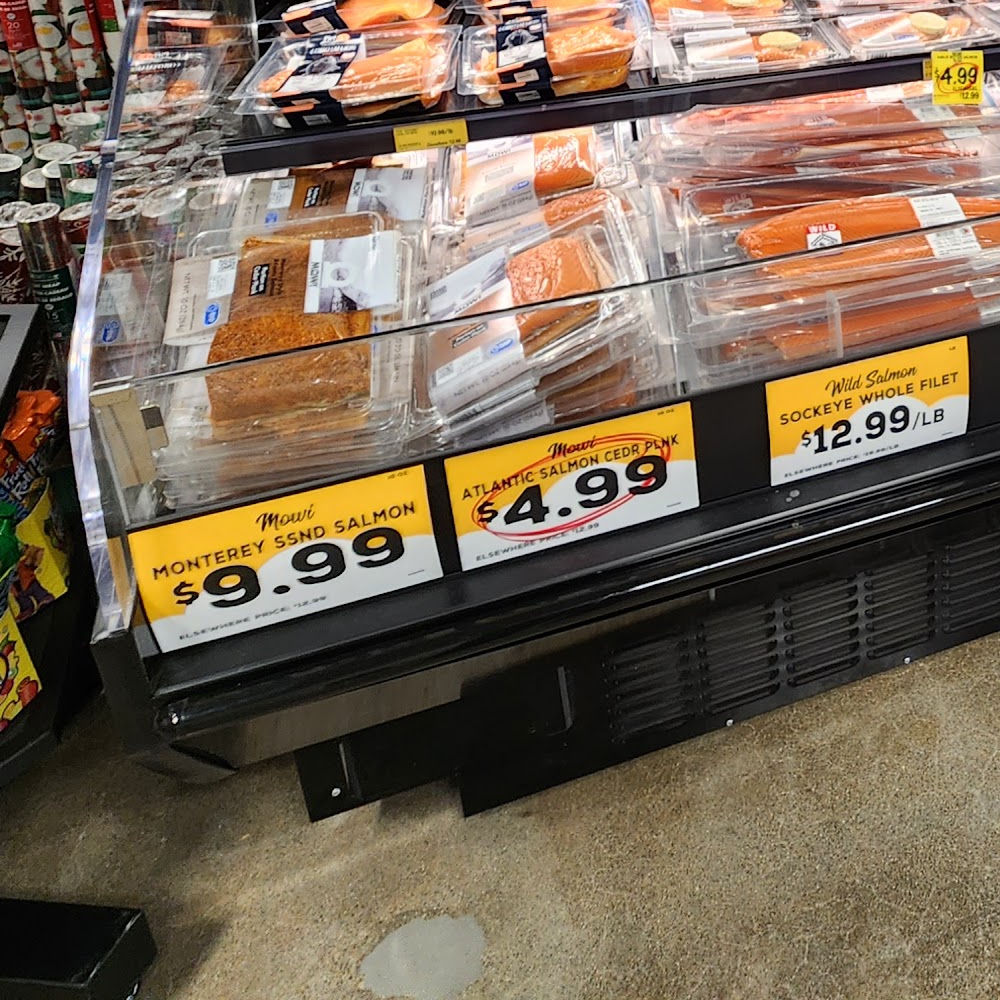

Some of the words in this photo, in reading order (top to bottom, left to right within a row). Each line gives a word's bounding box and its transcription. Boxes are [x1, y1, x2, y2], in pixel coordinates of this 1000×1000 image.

[808, 223, 837, 233] WILD
[308, 261, 320, 288] MOWI
[825, 378, 862, 397] Wild
[865, 366, 918, 389] Salmon
[780, 397, 853, 426] SOCKEYE
[859, 383, 914, 407] WHOLE
[920, 372, 959, 391] FILET
[547, 435, 597, 460] Mowi
[462, 471, 534, 500] ATLANTIC
[539, 453, 600, 479] SALMON
[604, 444, 641, 462] CEDR
[644, 434, 680, 451] PLNK
[477, 454, 668, 526] $4.99
[256, 504, 316, 533] Mowi
[153, 539, 264, 580] MONTEREY
[274, 523, 326, 549] SSND
[334, 501, 415, 534] SALMON
[475, 540, 536, 562] ELSEWHERE
[173, 526, 405, 609] $9.99
